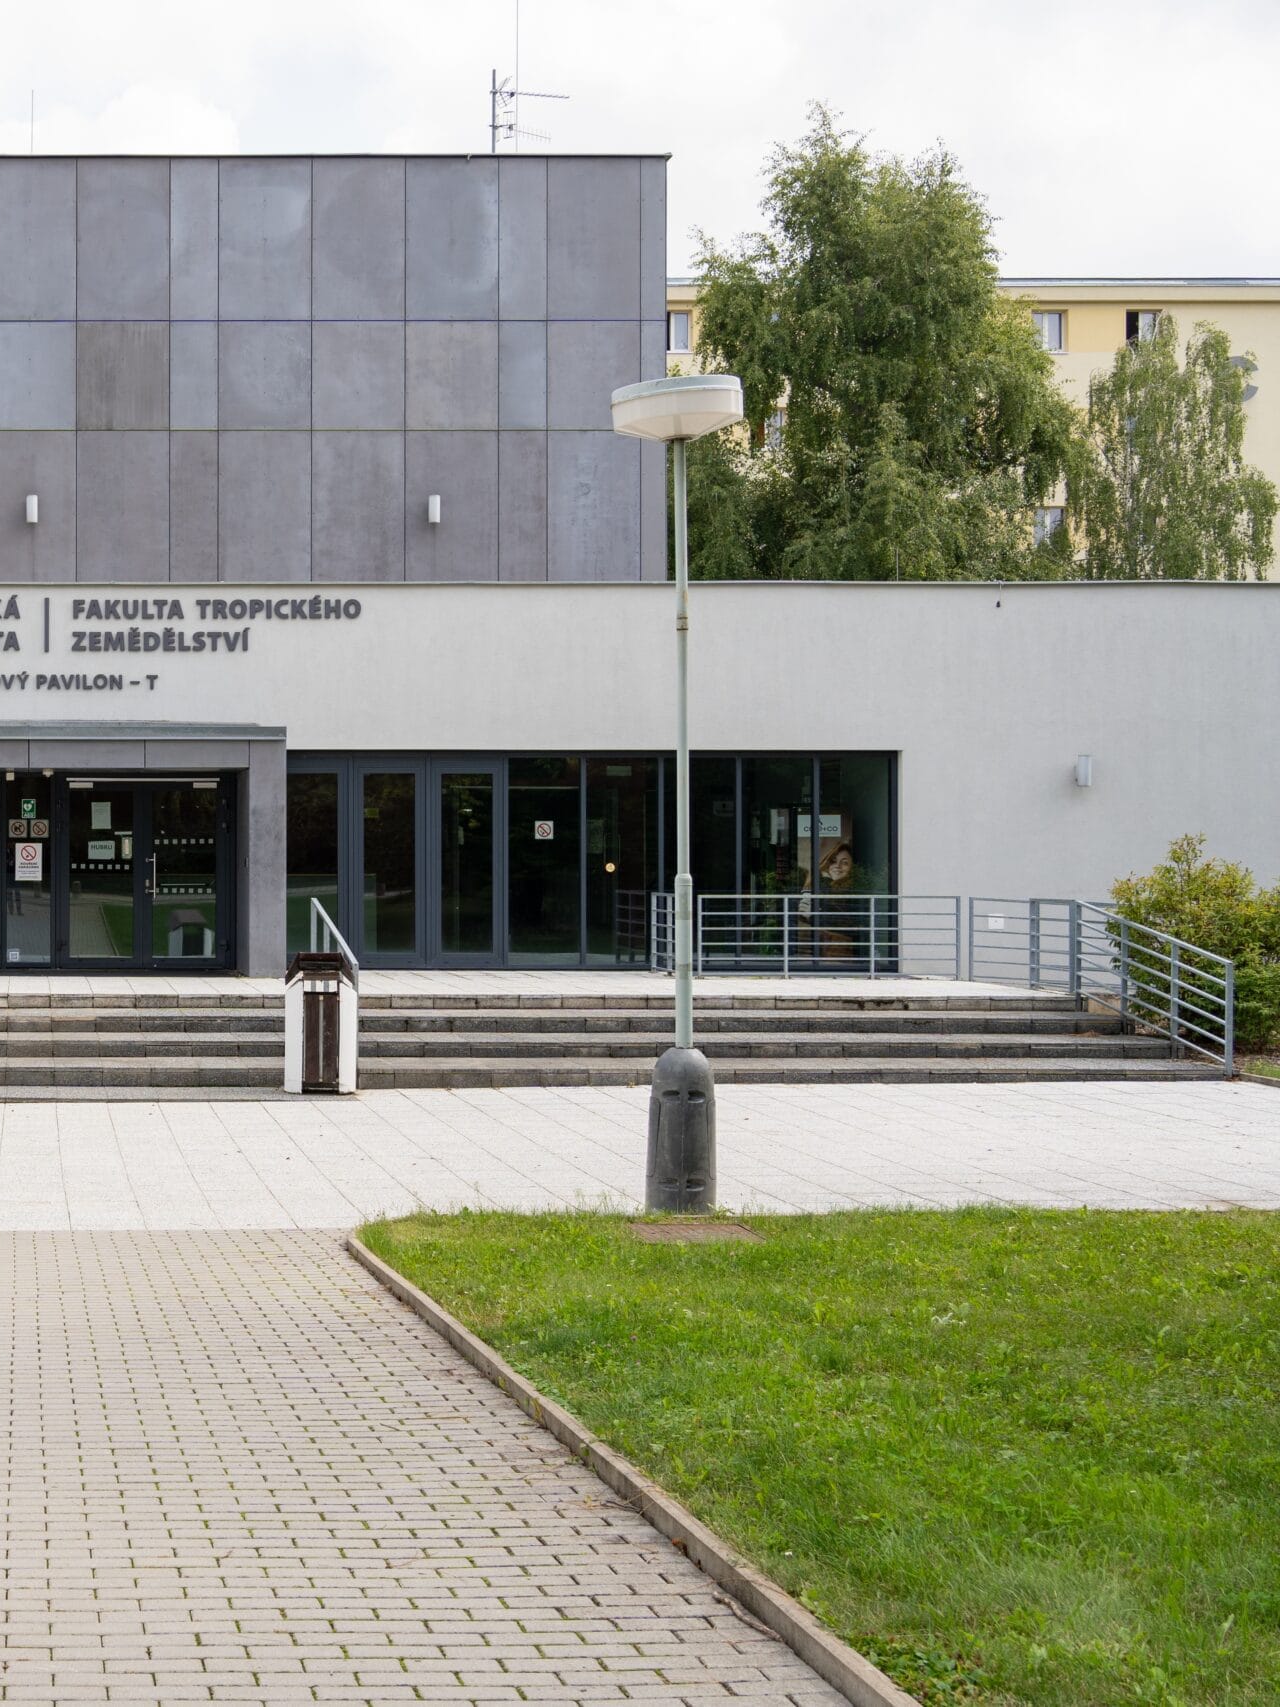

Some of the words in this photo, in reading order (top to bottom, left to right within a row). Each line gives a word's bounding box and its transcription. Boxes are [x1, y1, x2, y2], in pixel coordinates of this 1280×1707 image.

[72, 599, 185, 620] FAKULTA
[195, 595, 362, 620] TROPICKÉHO
[71, 627, 251, 652] ZEMĚDĚLSTVÍ
[35, 674, 123, 691] PAVILON
[145, 674, 159, 691] T
